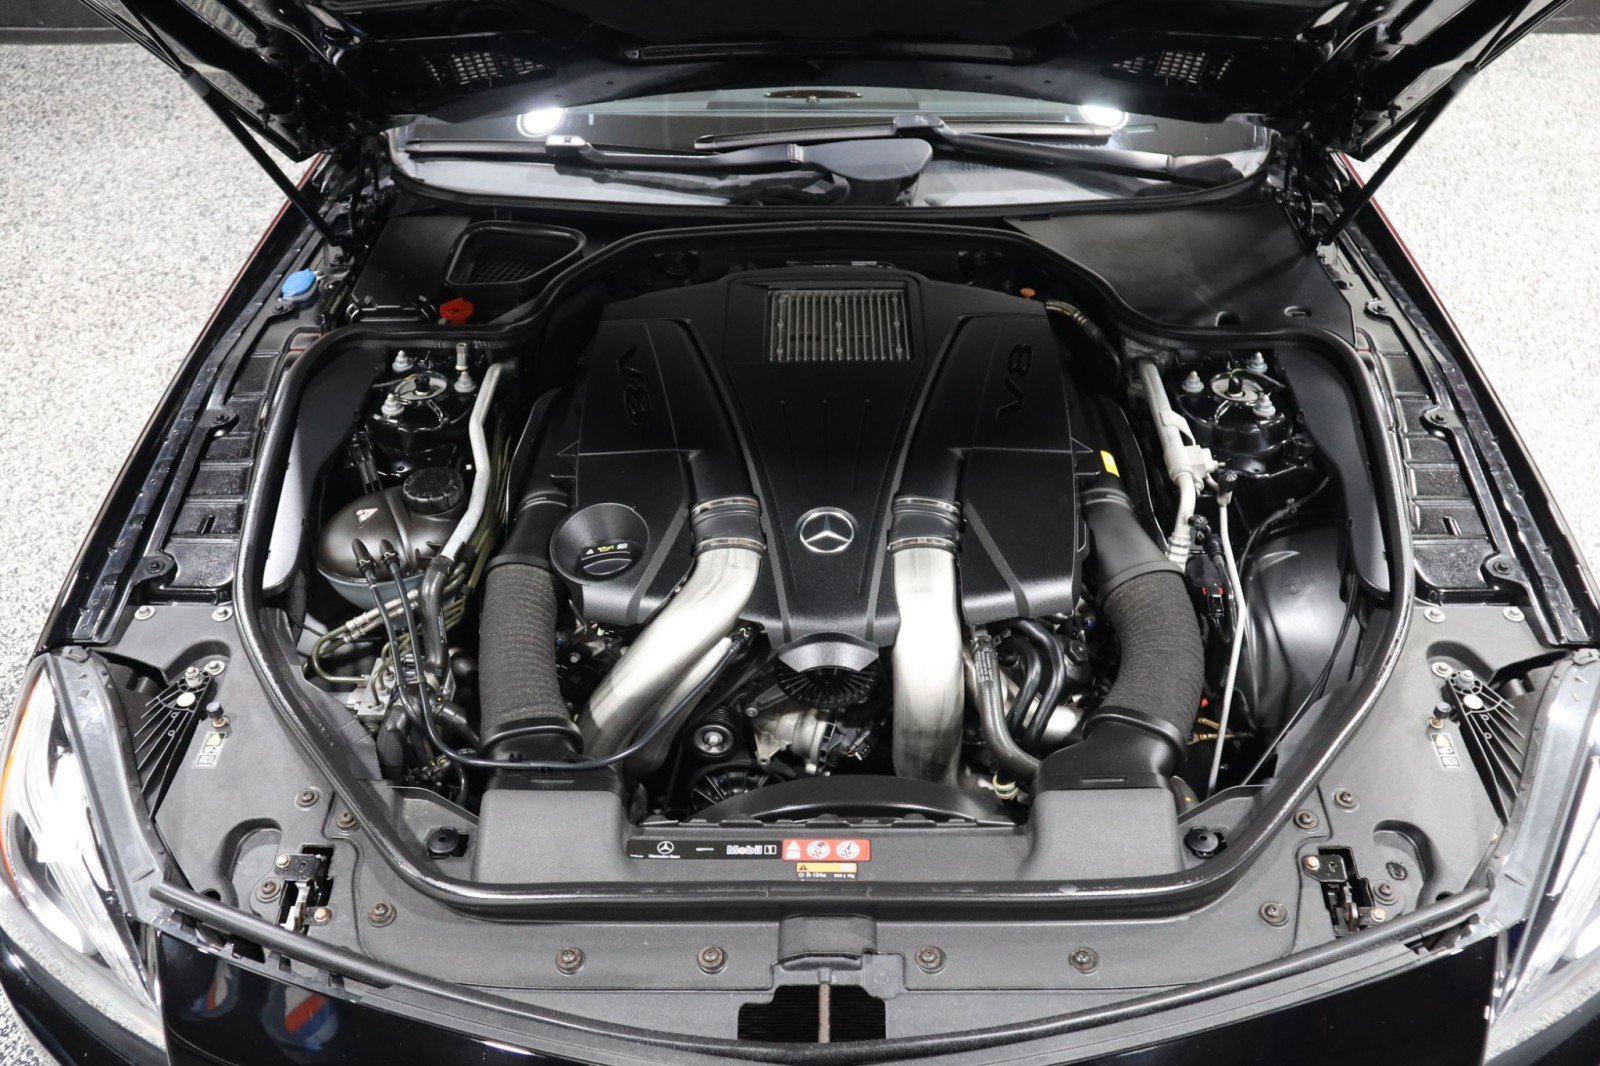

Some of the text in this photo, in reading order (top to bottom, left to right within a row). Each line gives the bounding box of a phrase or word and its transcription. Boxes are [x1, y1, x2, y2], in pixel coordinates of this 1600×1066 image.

[615, 344, 652, 426] V8
[995, 343, 1033, 417] V8
[726, 845, 763, 855] Mobil
